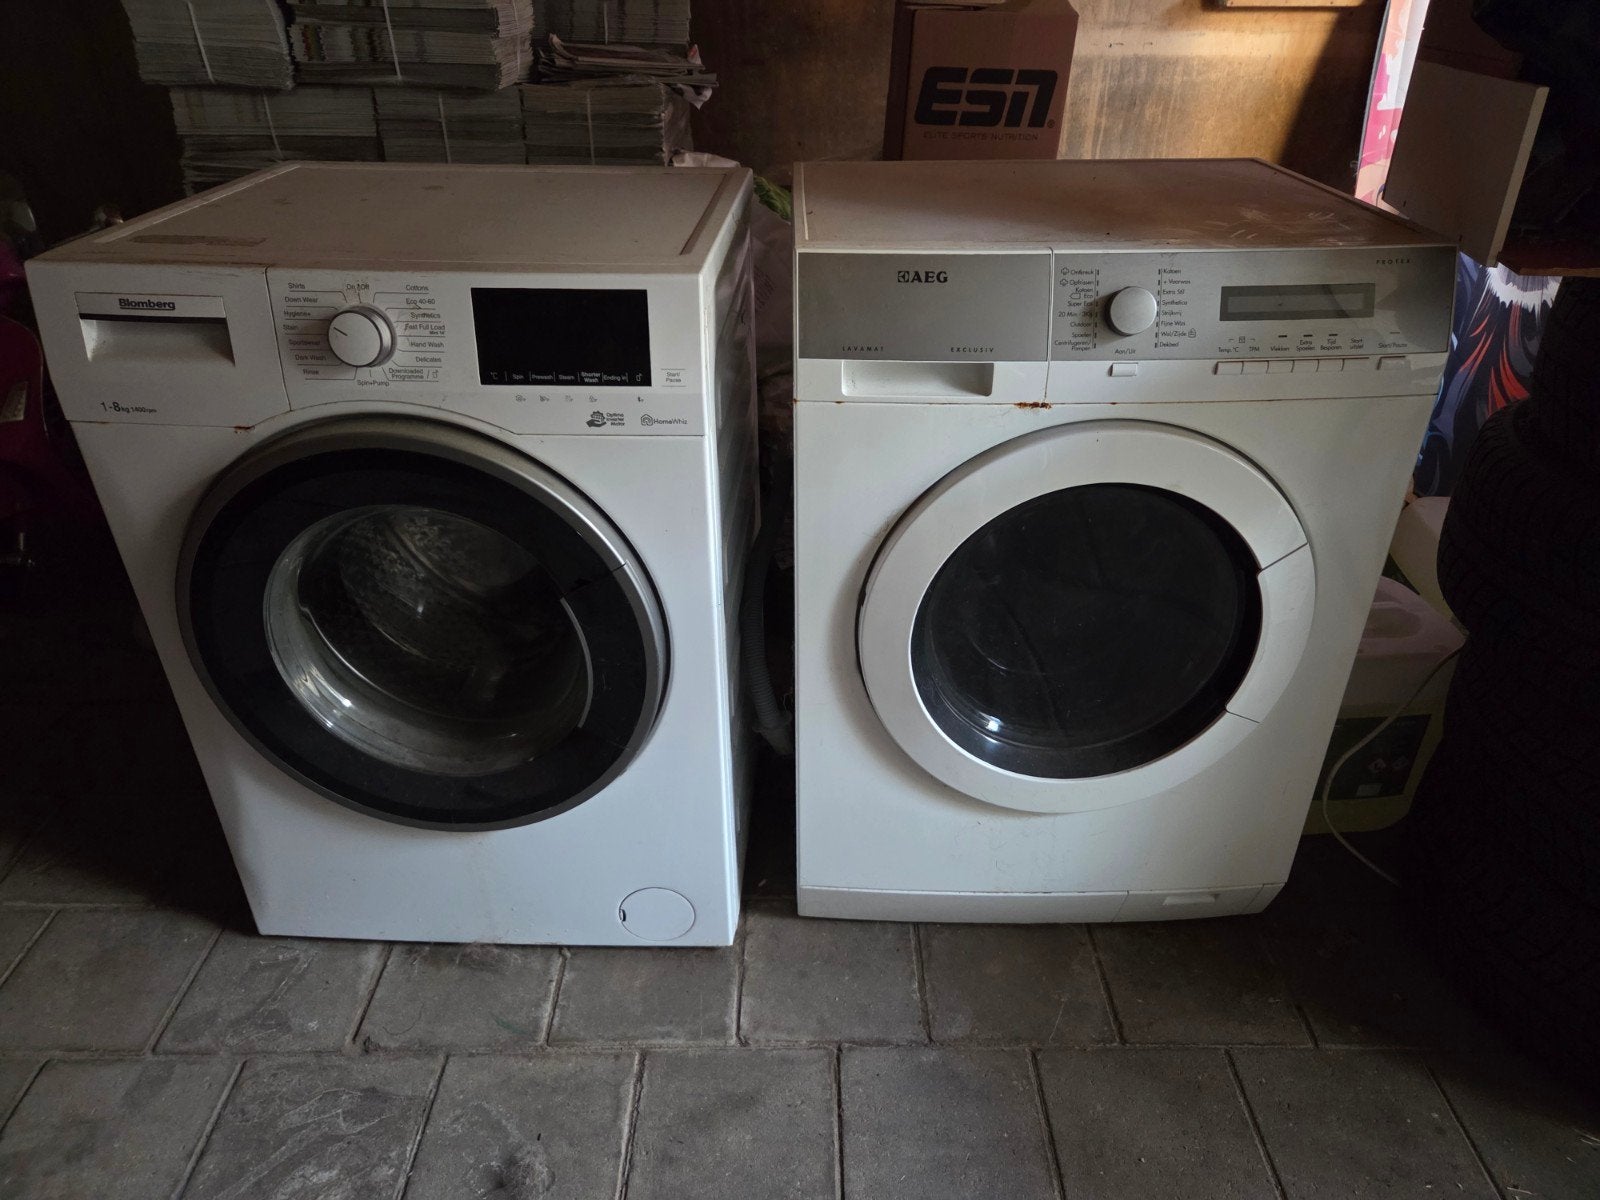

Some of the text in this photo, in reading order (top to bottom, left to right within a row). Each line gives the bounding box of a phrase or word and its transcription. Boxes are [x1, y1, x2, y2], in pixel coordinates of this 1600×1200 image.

[952, 132, 988, 140] SPORTS
[990, 133, 1039, 141] NUTRITION
[910, 270, 948, 283] AEG
[118, 298, 176, 310] Blomberg
